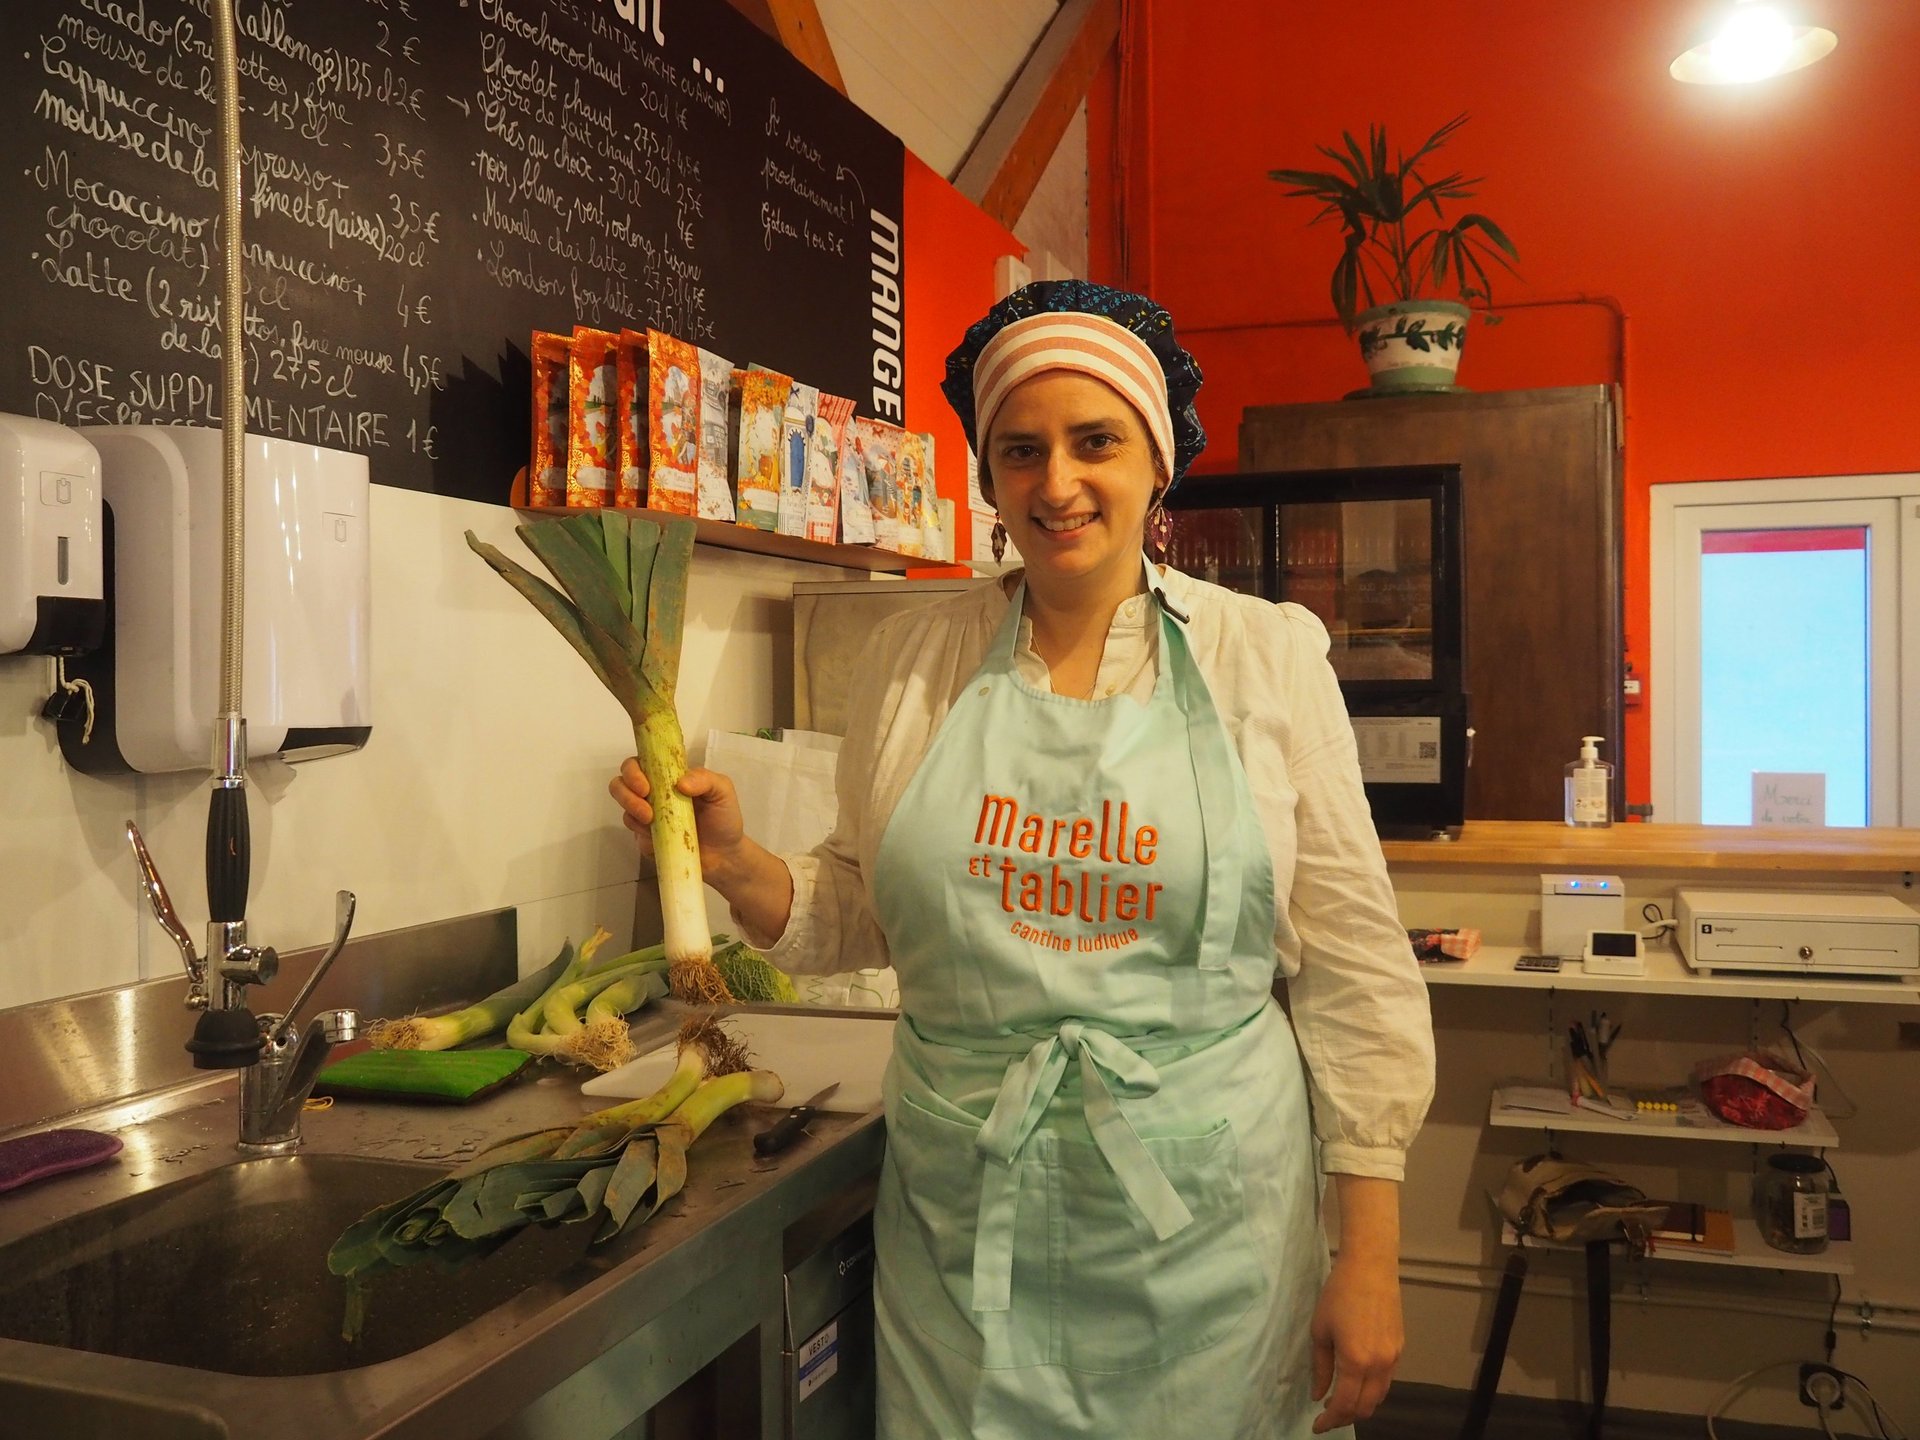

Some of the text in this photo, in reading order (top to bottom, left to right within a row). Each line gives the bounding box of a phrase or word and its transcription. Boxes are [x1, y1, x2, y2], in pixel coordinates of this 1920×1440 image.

[58, 13, 152, 74] mousse
[156, 54, 189, 90] de
[480, 31, 558, 101] Chocolat
[564, 77, 618, 138] chaud
[33, 88, 149, 157] mousse
[40, 34, 213, 148] Cappuccino
[535, 98, 555, 126] de
[528, 134, 549, 160] au
[553, 134, 595, 183] choix
[41, 229, 139, 303] Latte
[160, 318, 191, 353] de
[28, 344, 116, 402] DOSE
[128, 369, 391, 452] SUPPLMENTAIRE
[998, 856, 1164, 923] tablier
[1010, 919, 1139, 953] cantine ludique
